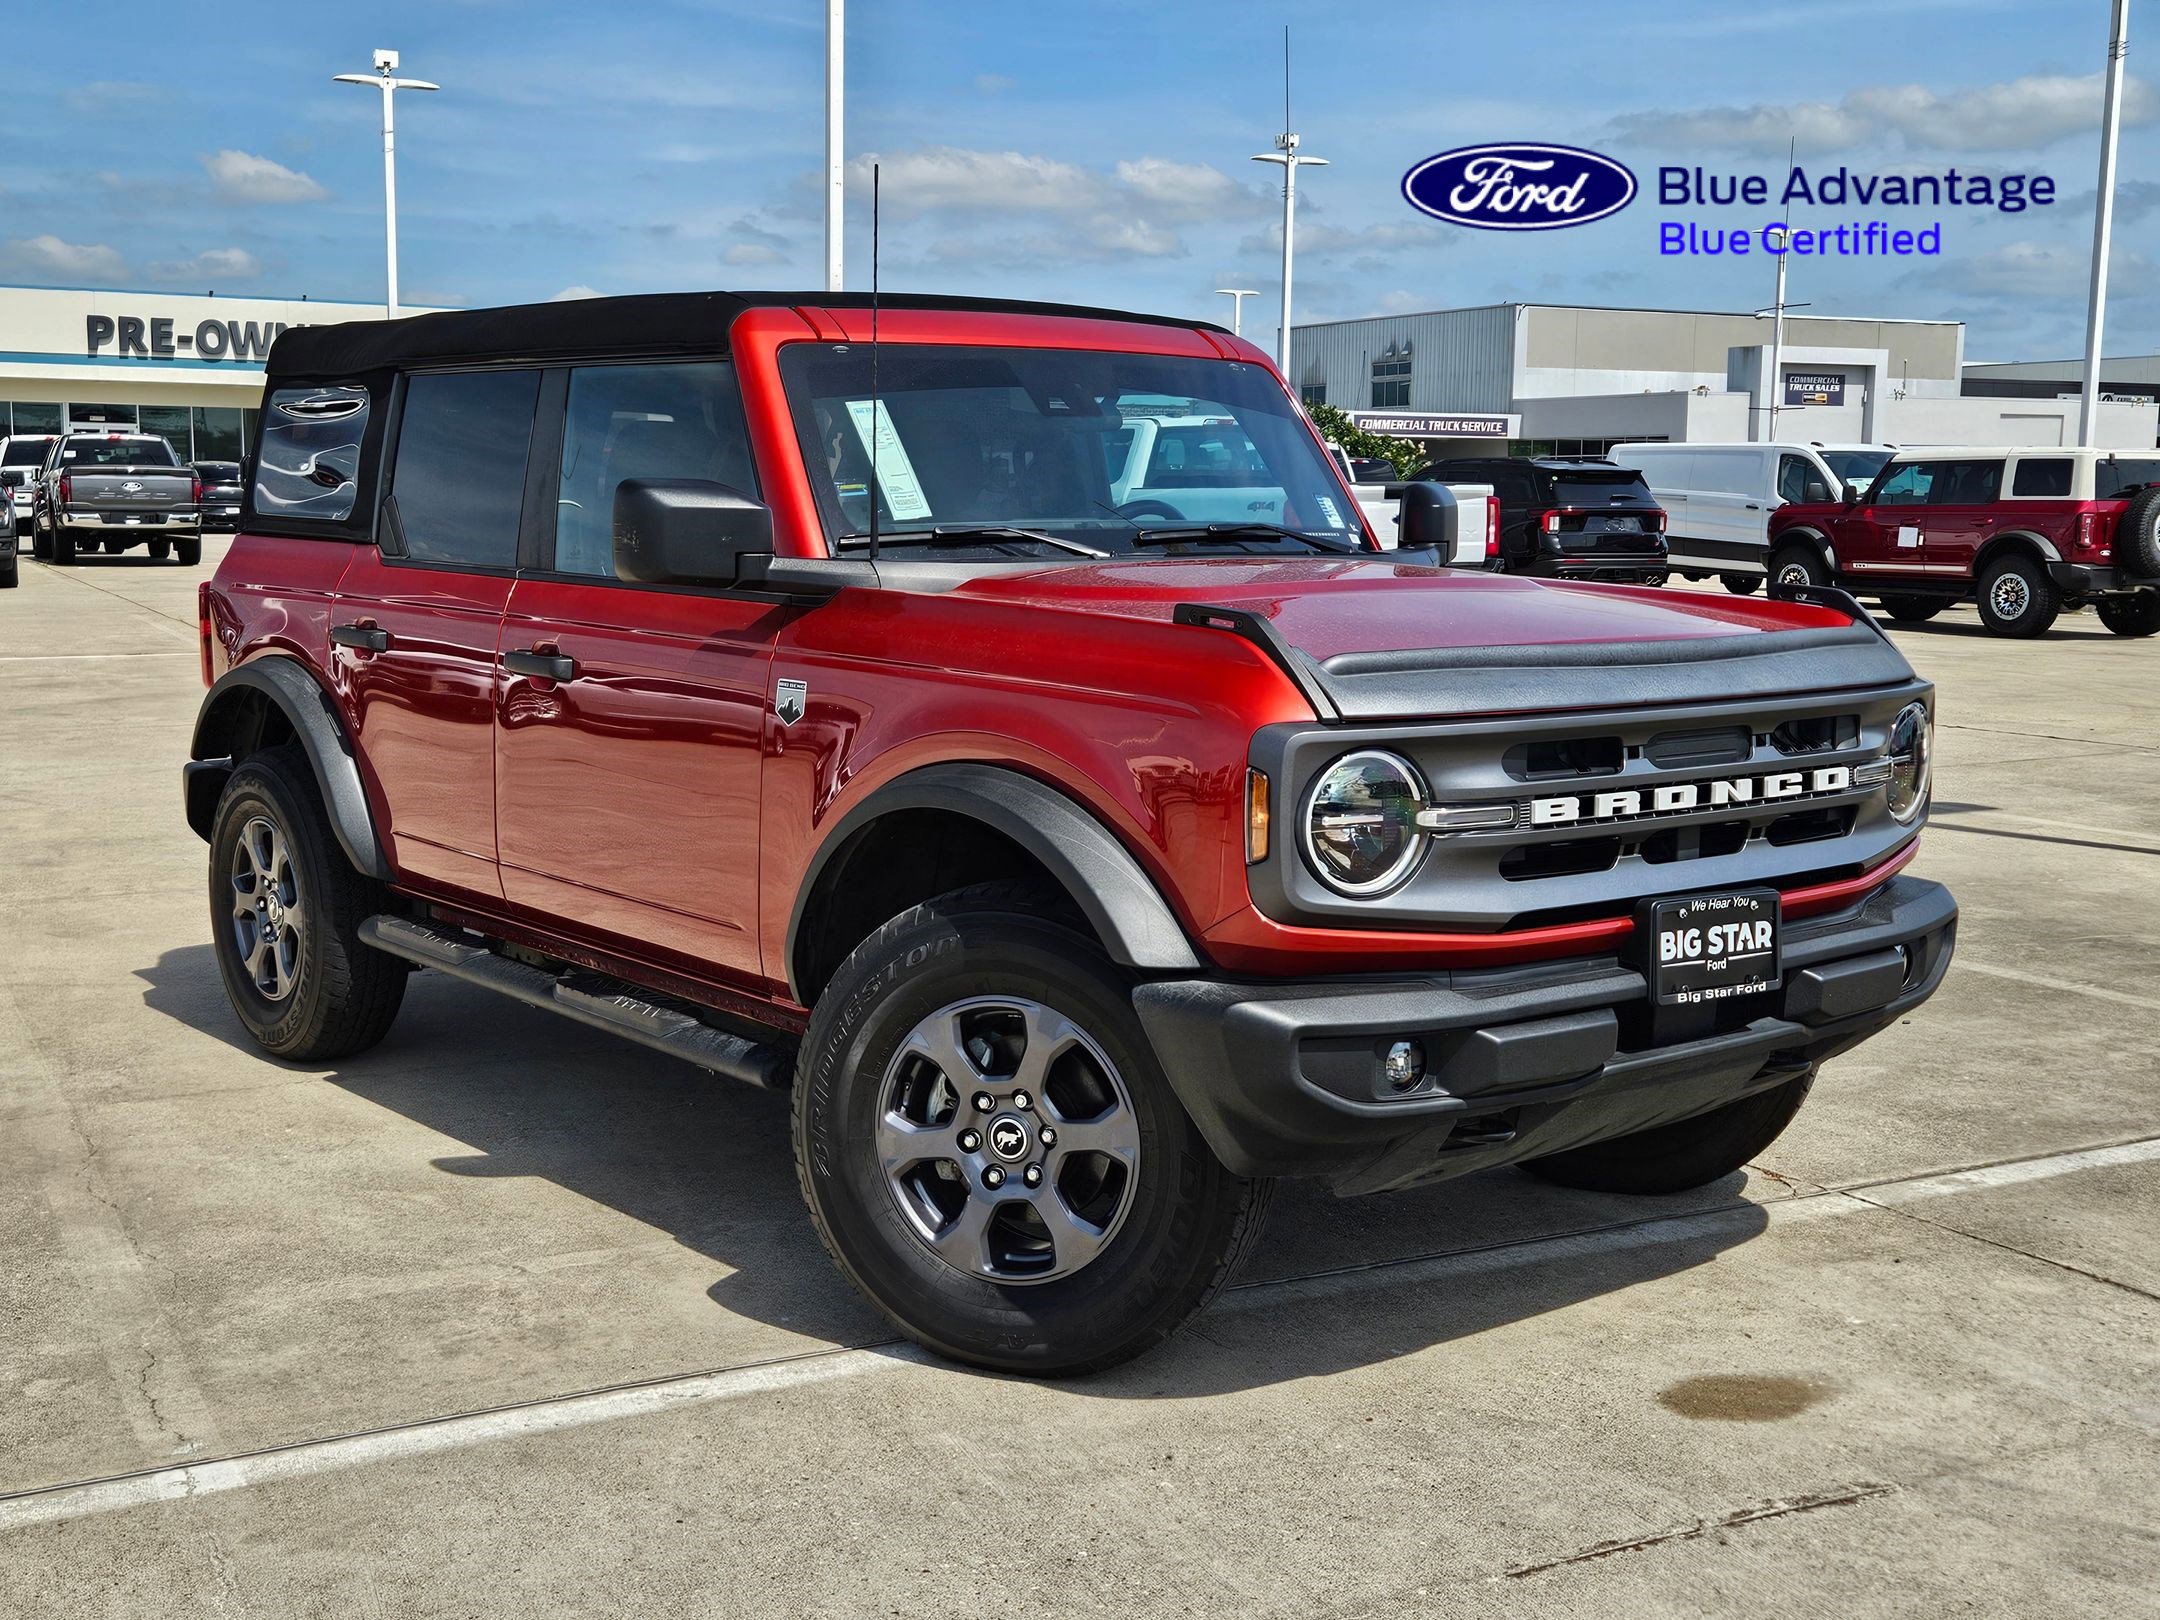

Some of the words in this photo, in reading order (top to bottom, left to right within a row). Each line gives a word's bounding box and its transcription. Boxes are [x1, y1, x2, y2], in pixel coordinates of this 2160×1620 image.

[86, 314, 332, 357] PRE-OW
[1789, 376, 1840, 384] COMMERCIAL
[1789, 383, 1815, 391] TRUCK
[1359, 418, 1427, 431] COMMERCIAL
[1428, 420, 1462, 431] TRUCK
[1461, 421, 1504, 432] SERVICE
[1531, 766, 1850, 825] BRONCO
[1691, 900, 1707, 912] We
[1708, 898, 1732, 911] Hear
[1732, 896, 1750, 908] You
[1660, 927, 1702, 962] BIG
[1707, 920, 1773, 955] STAR
[1707, 957, 1727, 972] Ford
[1677, 991, 1701, 1004] Big
[1705, 987, 1733, 1000] Star
[1736, 981, 1767, 995] Ford
[808, 934, 966, 1178] BRIDGESTON
